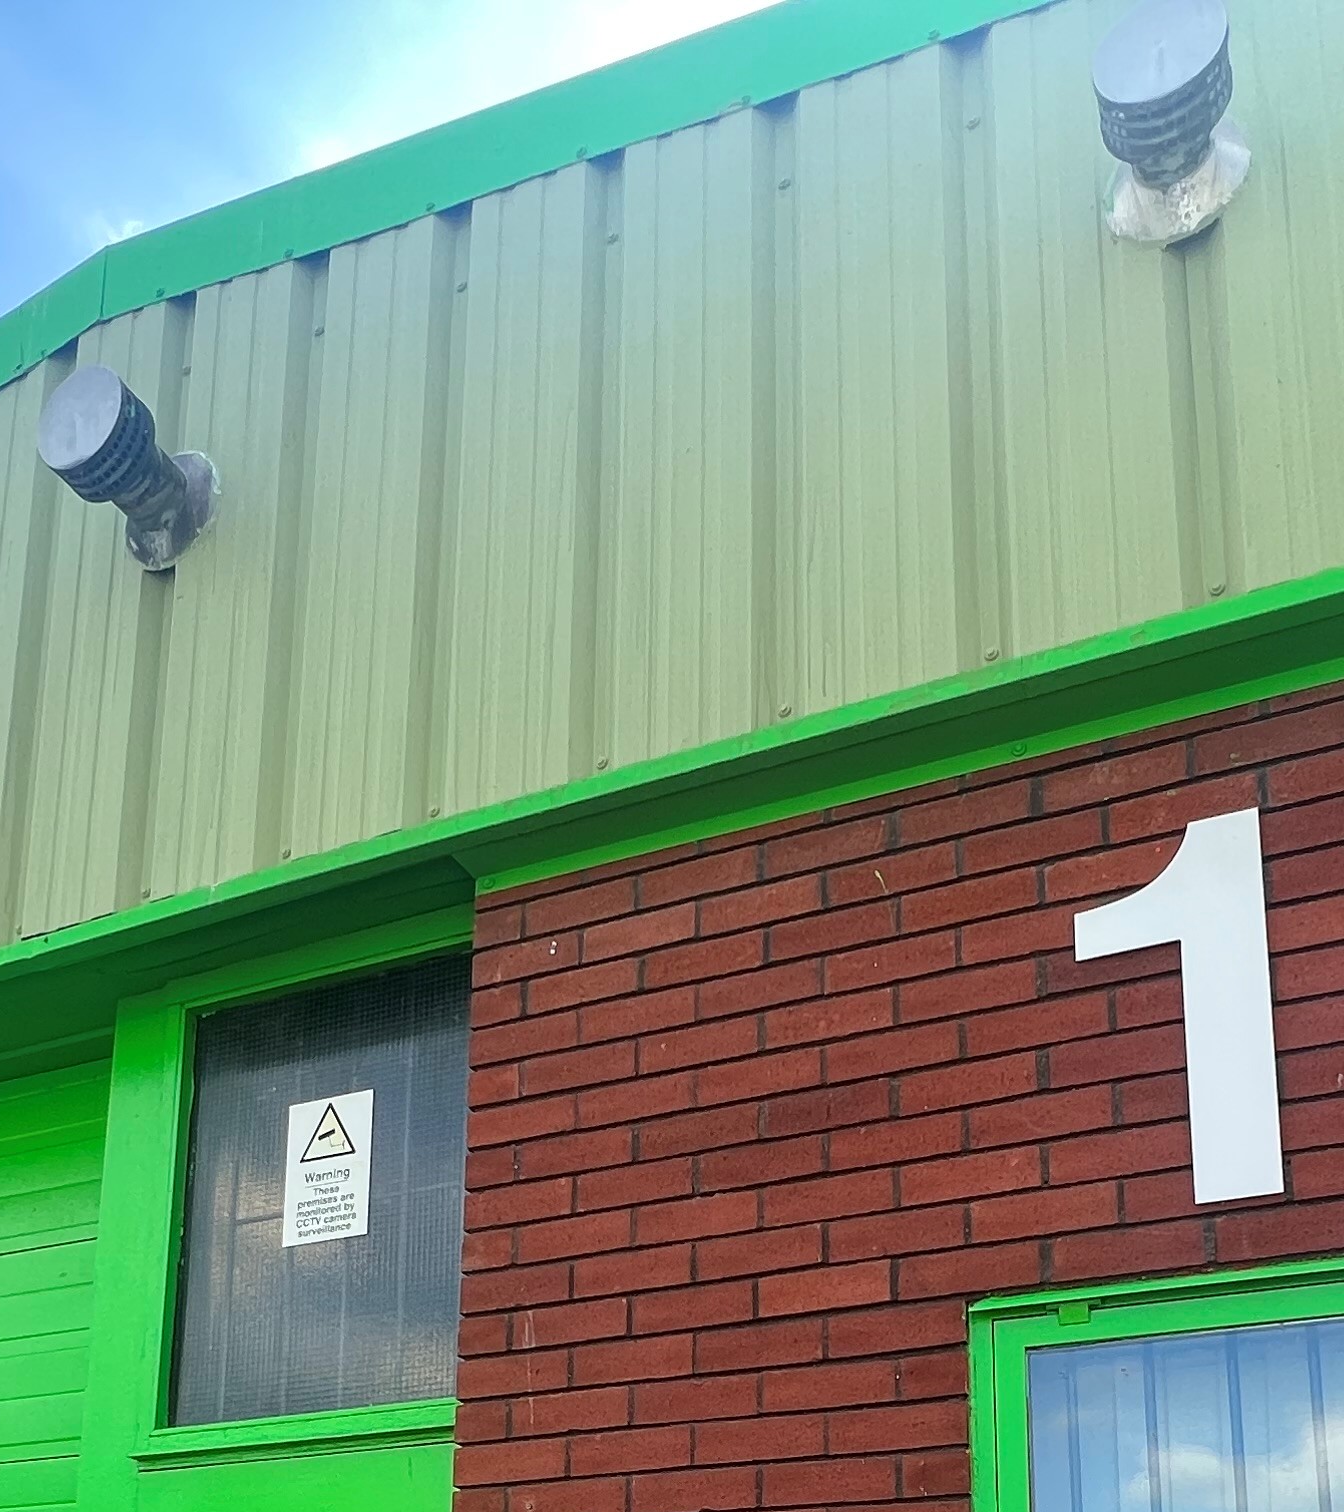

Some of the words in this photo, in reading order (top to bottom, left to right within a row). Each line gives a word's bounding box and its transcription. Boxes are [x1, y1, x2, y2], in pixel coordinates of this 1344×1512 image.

[305, 1169, 350, 1183] Warning
[313, 1186, 340, 1195] These
[297, 1196, 338, 1211] premises
[340, 1193, 355, 1201] are
[296, 1203, 342, 1218] monitored
[343, 1202, 355, 1212] by
[296, 1216, 321, 1229] CCTV
[323, 1212, 357, 1223] camera
[298, 1223, 351, 1237] surveillance
